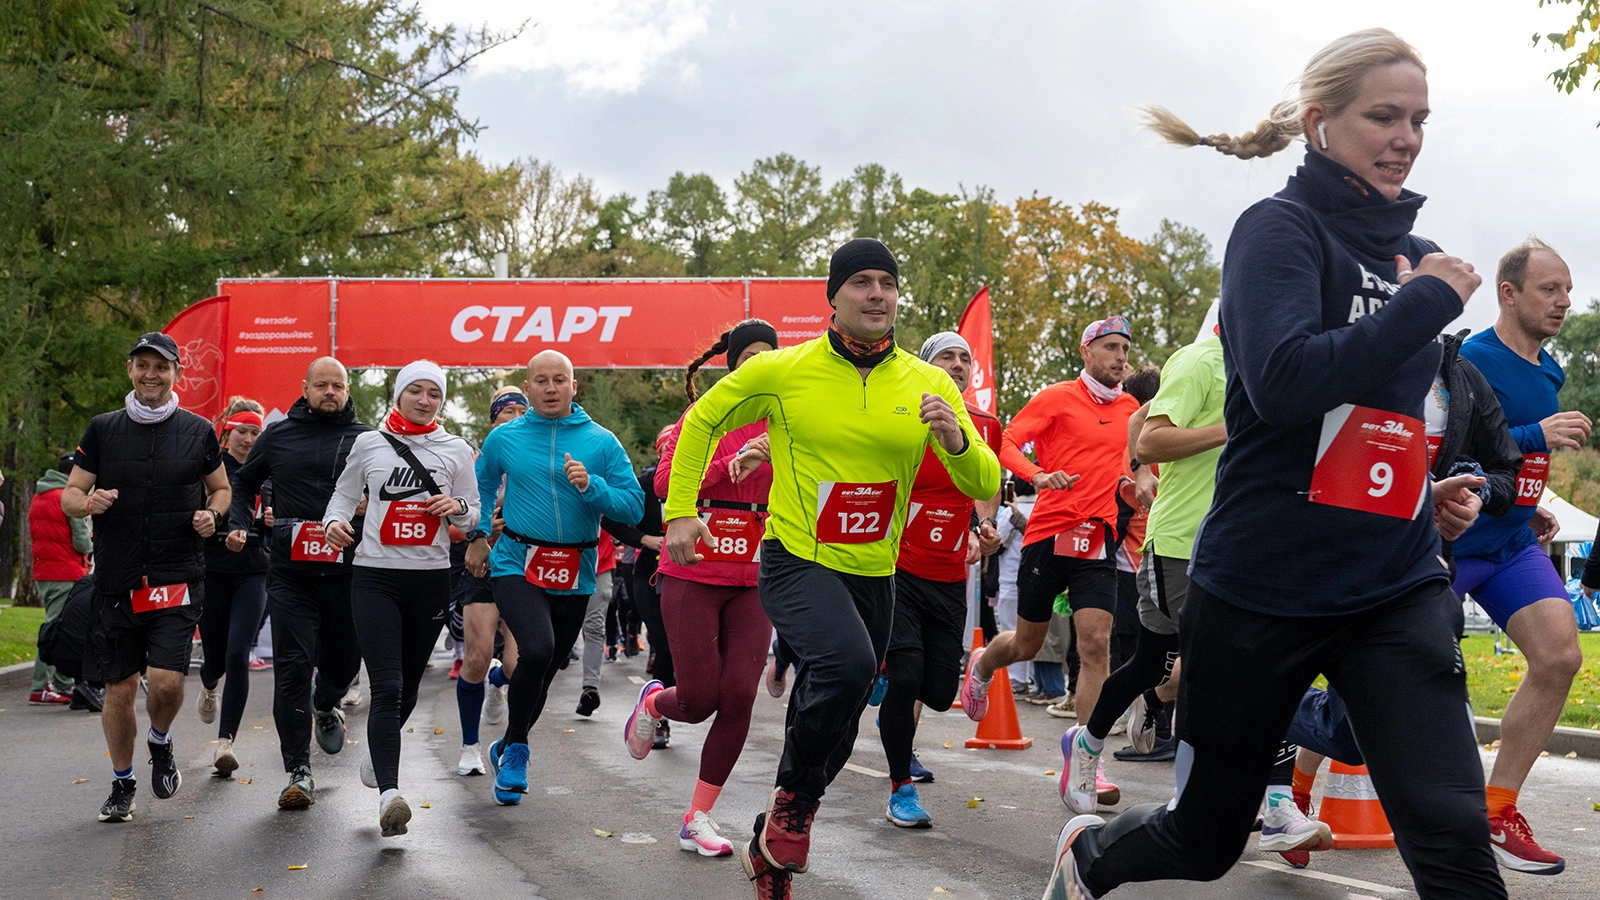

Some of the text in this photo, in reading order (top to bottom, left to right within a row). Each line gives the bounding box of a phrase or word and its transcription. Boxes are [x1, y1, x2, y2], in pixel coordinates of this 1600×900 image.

[254, 316, 298, 325] #ветзабег
[450, 305, 633, 343] СТАРТ
[782, 315, 824, 324] #ветзабег
[1367, 462, 1394, 498] 9
[1518, 477, 1543, 498] 139
[392, 522, 426, 539] 158
[838, 512, 880, 534] 122
[930, 526, 943, 543] 6
[302, 541, 334, 556] 184
[1072, 536, 1090, 553] 18
[537, 565, 570, 584] 148
[148, 587, 169, 603] 41
